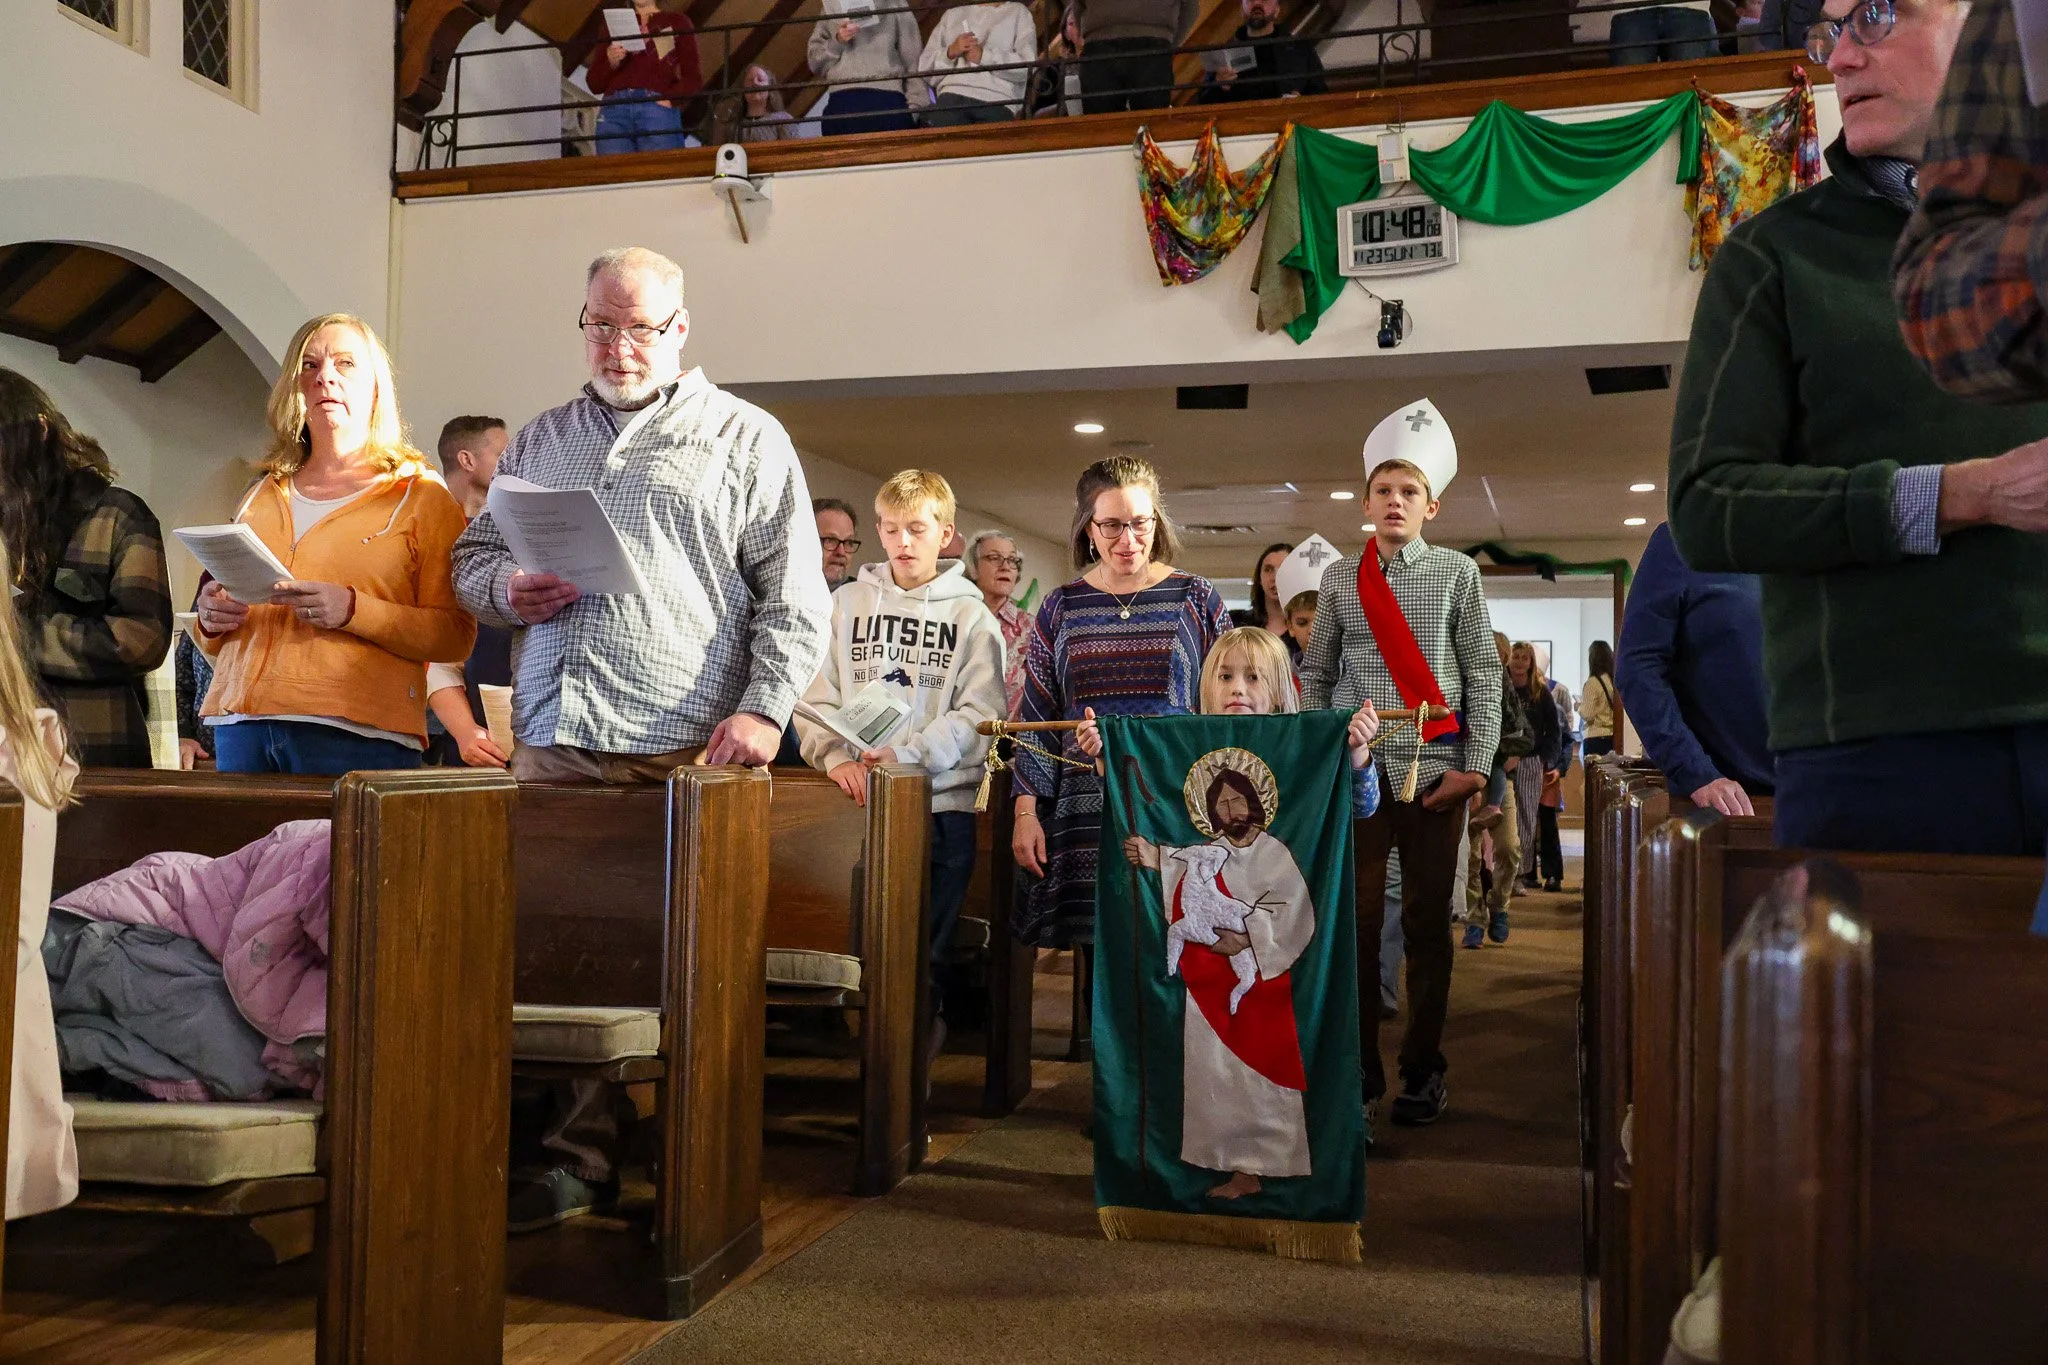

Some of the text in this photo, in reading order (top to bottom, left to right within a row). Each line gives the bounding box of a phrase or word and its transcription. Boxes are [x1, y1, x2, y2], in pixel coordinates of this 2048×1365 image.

[1361, 205, 1425, 243] 10:48
[852, 614, 958, 652] LUTSEN
[854, 668, 878, 681] NOTH
